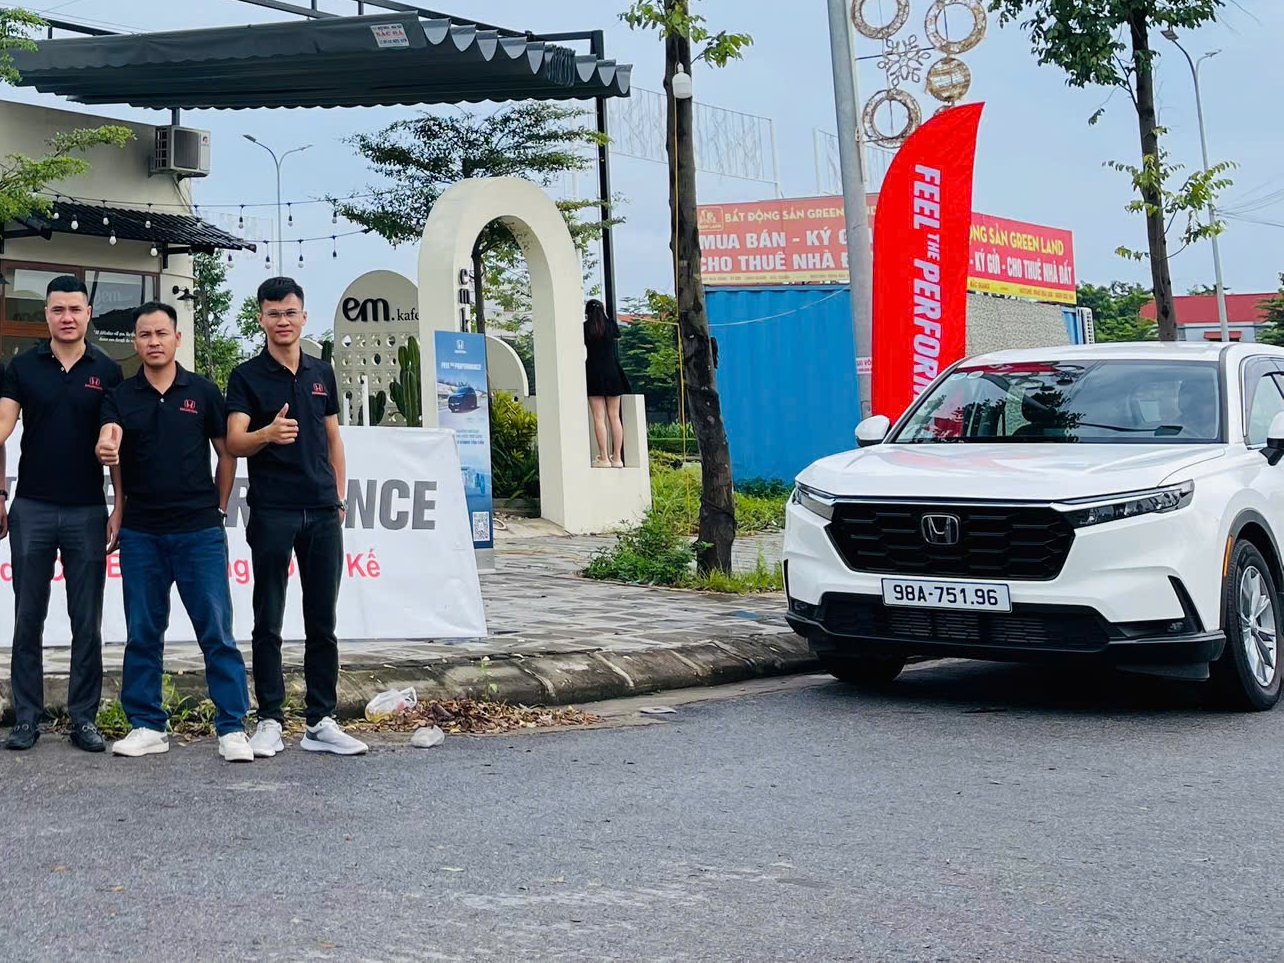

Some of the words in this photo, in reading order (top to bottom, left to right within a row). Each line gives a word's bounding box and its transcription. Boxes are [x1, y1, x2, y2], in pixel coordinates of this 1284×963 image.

[913, 164, 941, 230] FEEL
[747, 208, 780, 225] ĐỘNG
[807, 207, 845, 219] GREEN
[700, 235, 741, 250] MUA
[746, 231, 786, 249] BÁN
[806, 226, 831, 246] KÝ
[926, 233, 941, 261] THE
[1009, 231, 1040, 252] GREEN
[1041, 236, 1064, 256] LAND
[738, 253, 787, 271] THUÊ
[793, 250, 835, 269] NHÀ
[974, 248, 986, 272] KÝ
[1007, 256, 1023, 278] CHO
[1023, 258, 1043, 281] THUÊ
[346, 549, 381, 578] Kế
[893, 584, 998, 606] 98A-751.96
